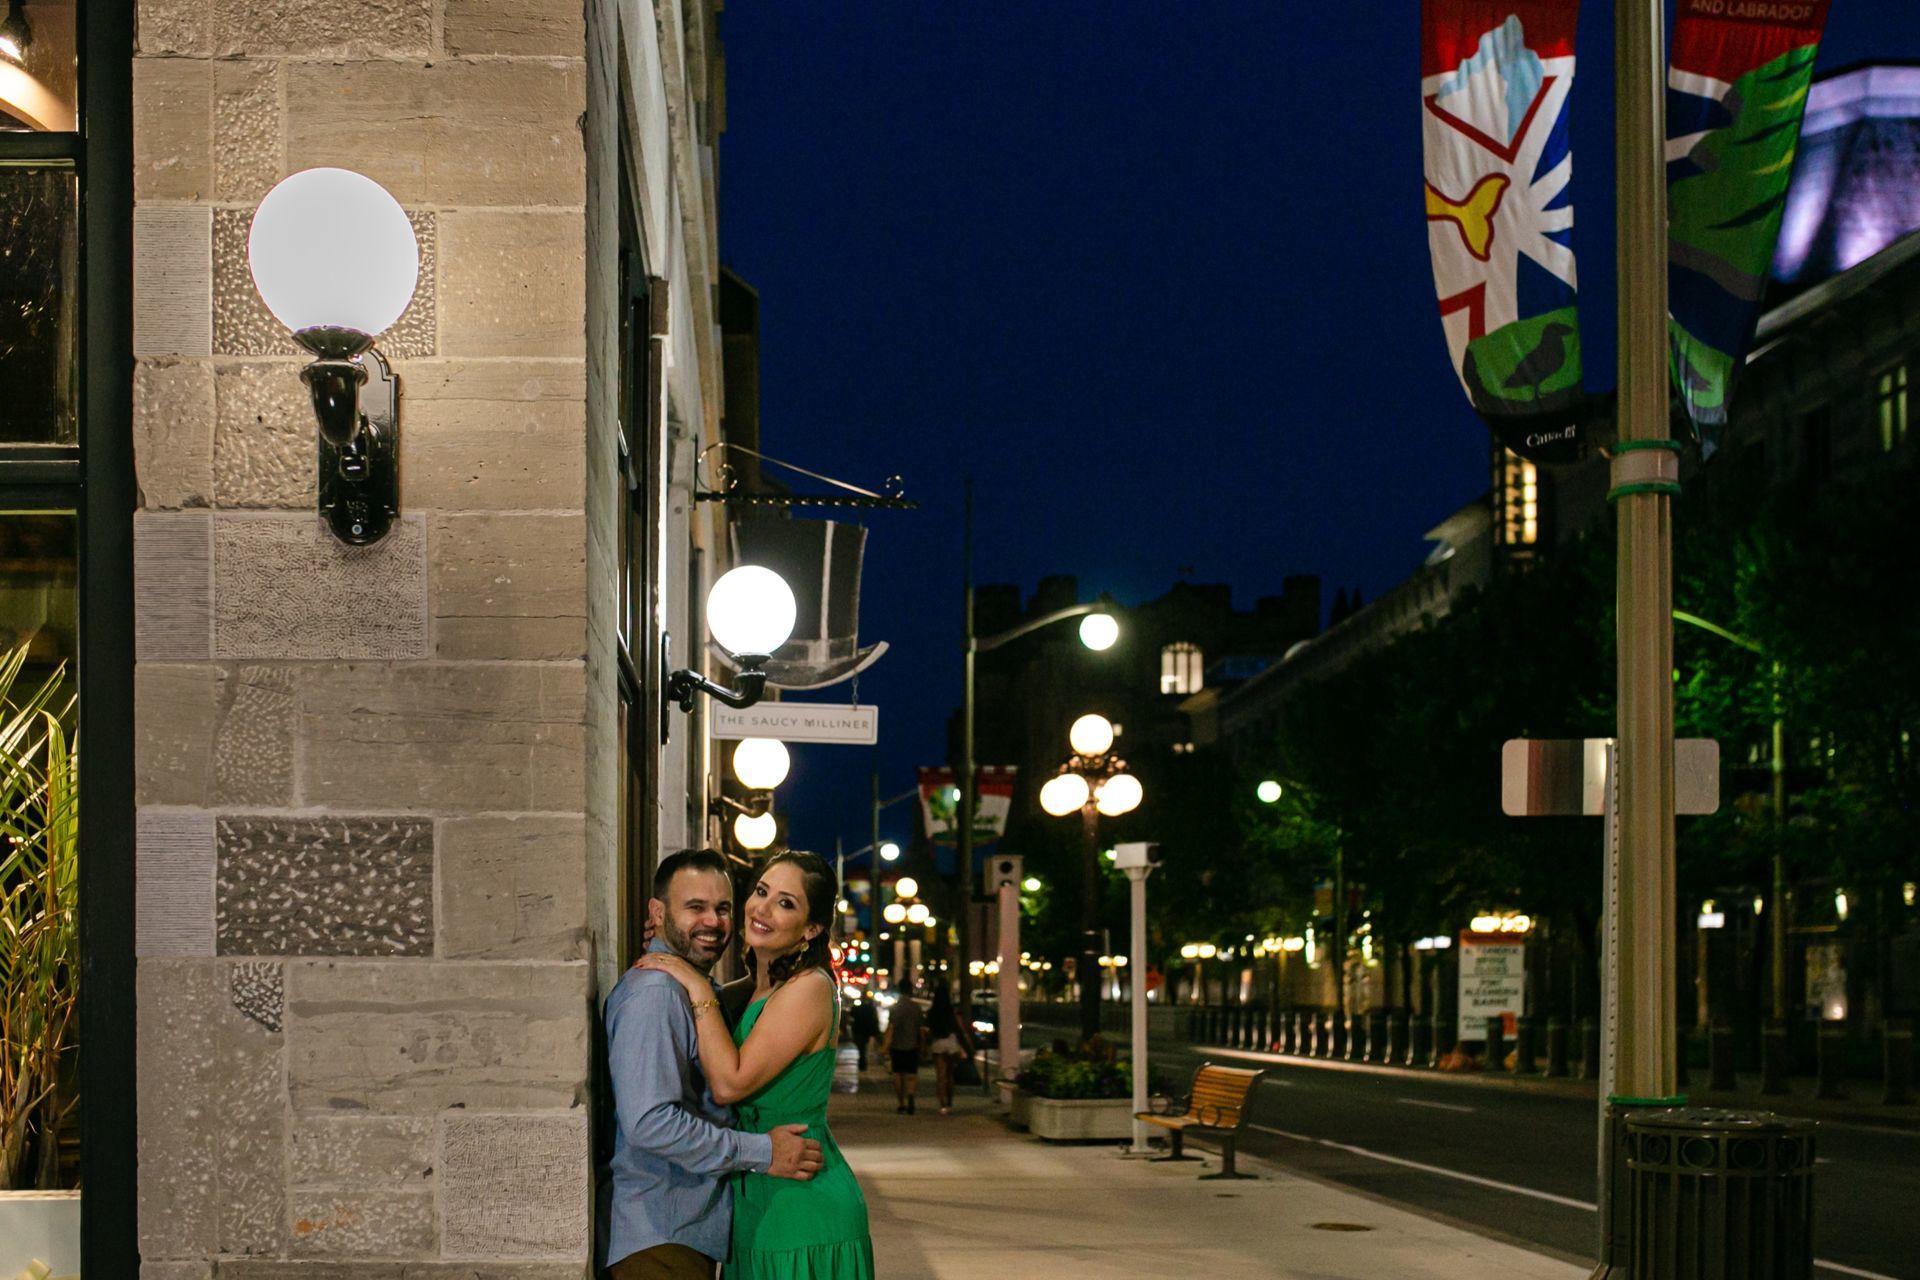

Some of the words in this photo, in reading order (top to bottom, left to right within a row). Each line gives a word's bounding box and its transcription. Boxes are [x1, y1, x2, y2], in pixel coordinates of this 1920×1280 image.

[1690, 0, 1724, 14] AND
[1727, 2, 1814, 21] LABRADOR
[719, 715, 745, 726] THE
[751, 716, 798, 728] SAUCY
[804, 718, 870, 729] MILLINER
